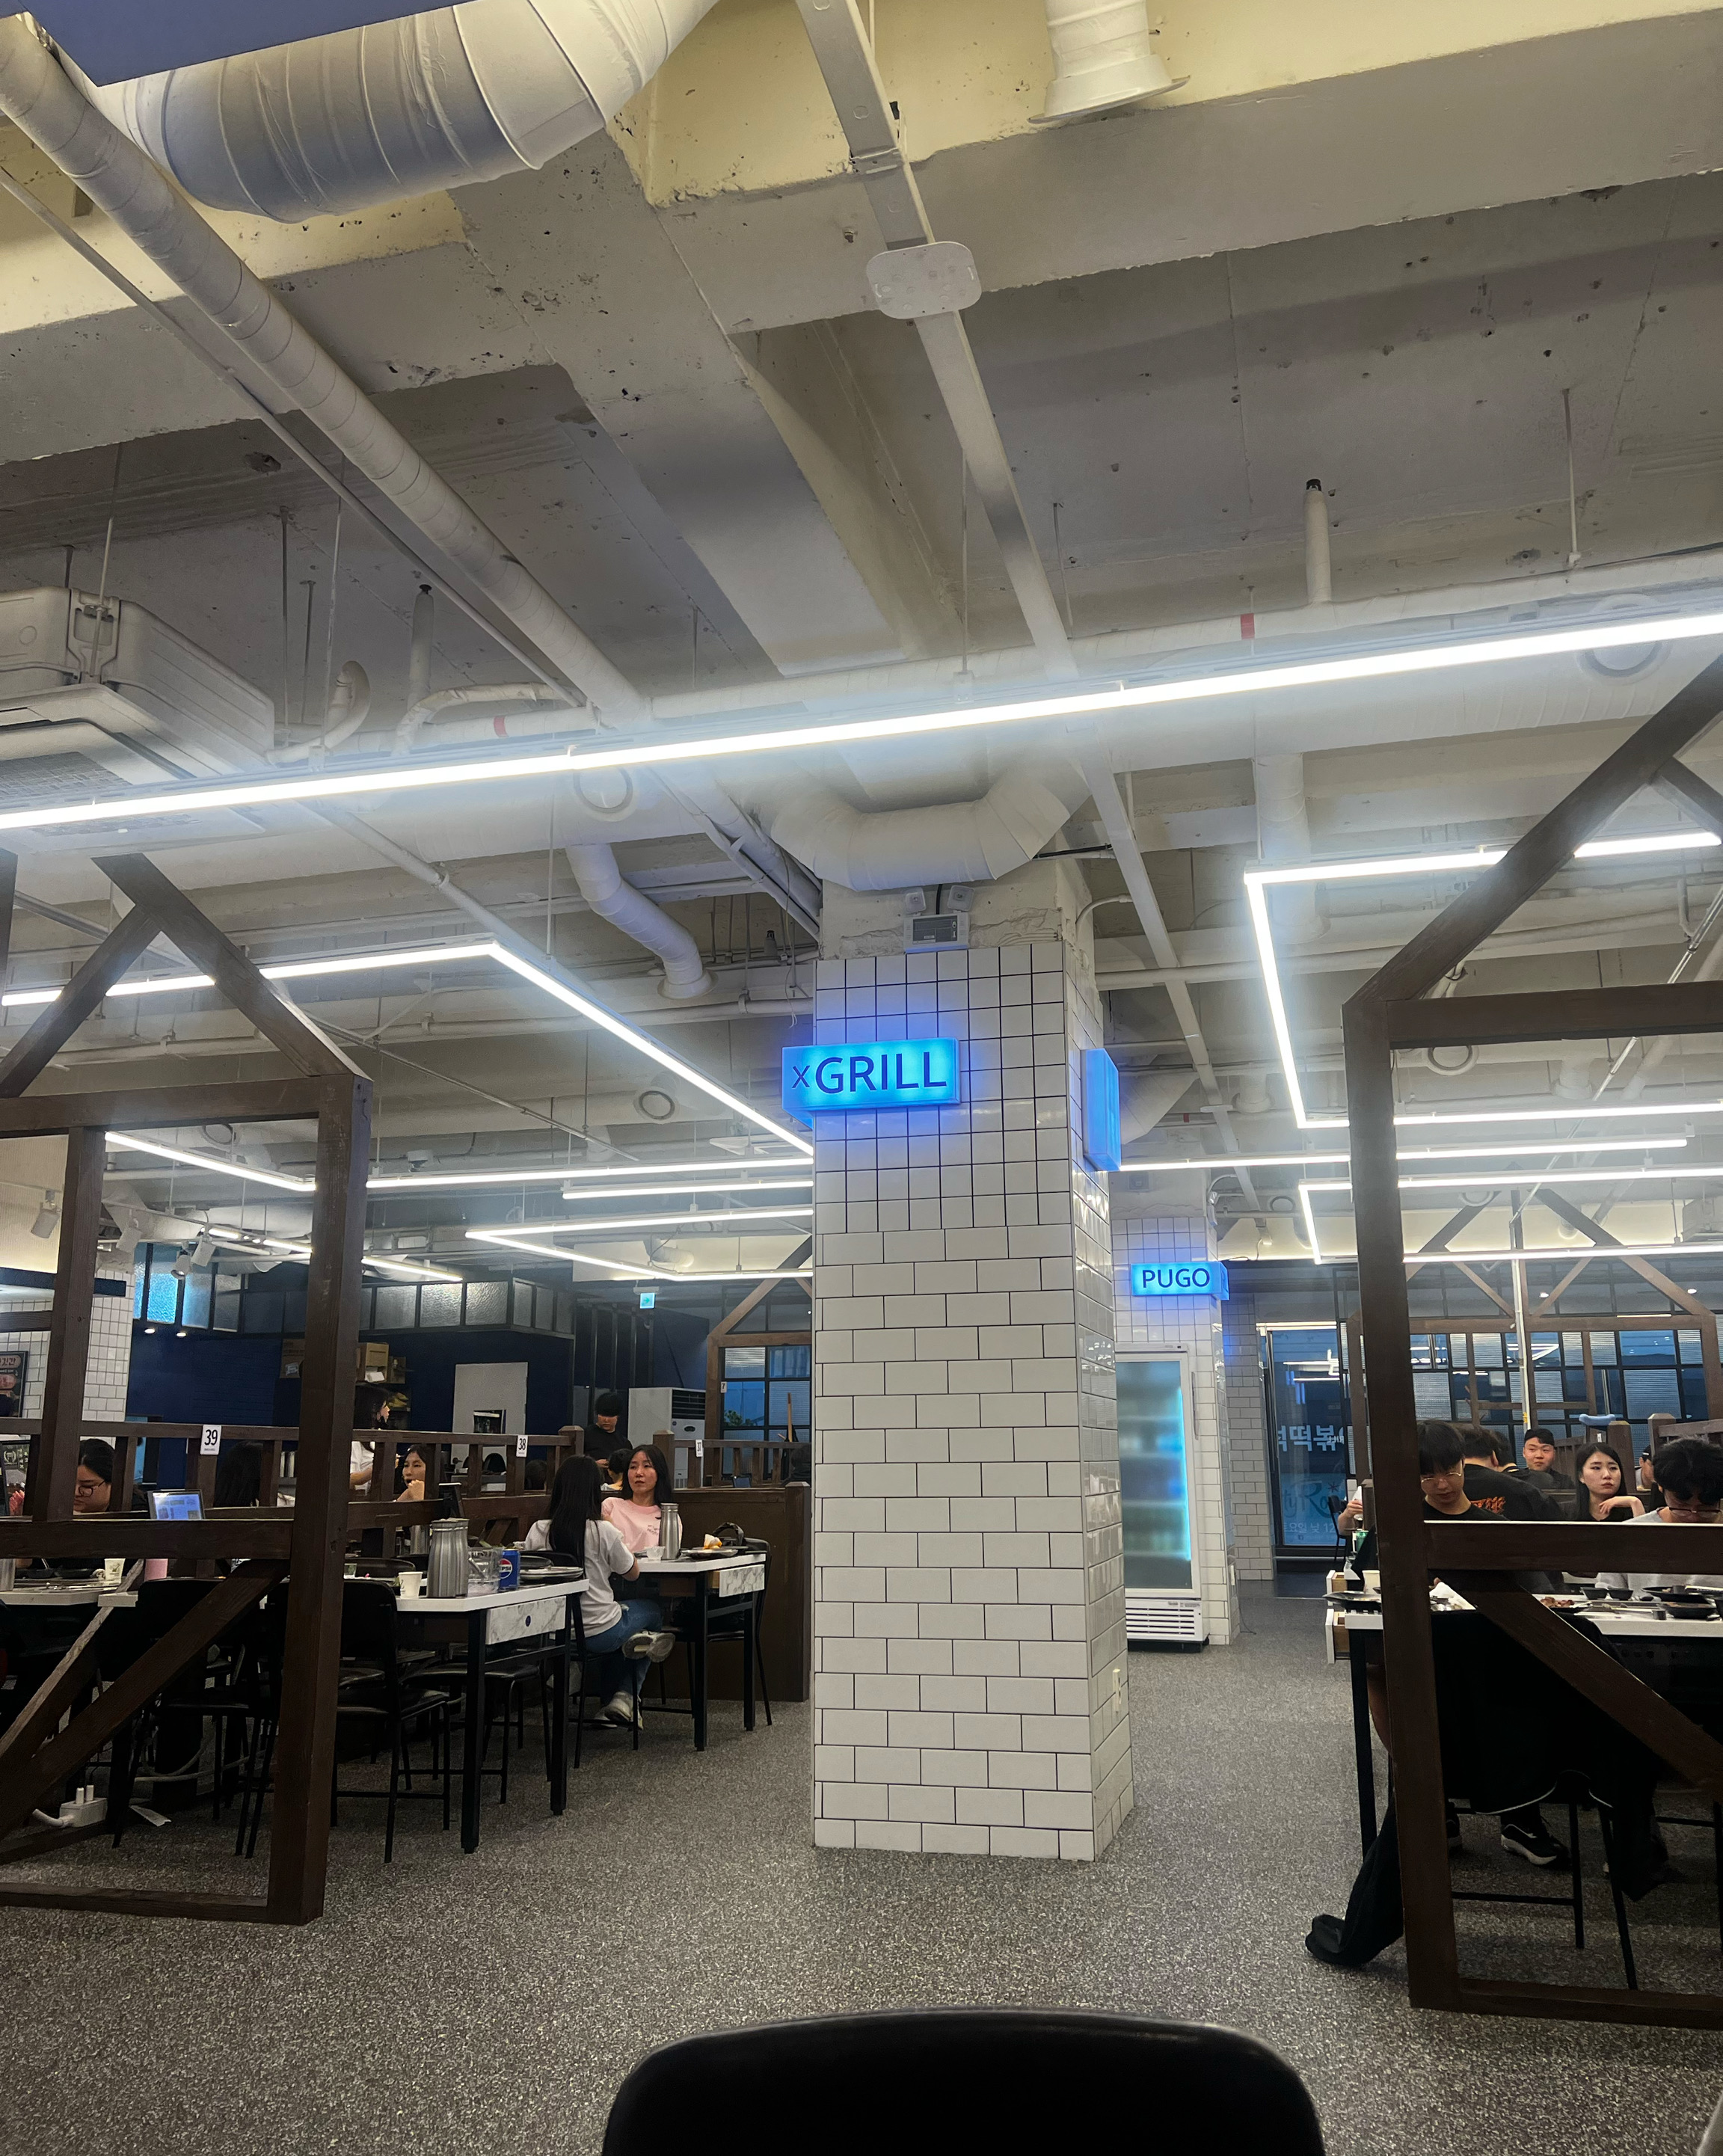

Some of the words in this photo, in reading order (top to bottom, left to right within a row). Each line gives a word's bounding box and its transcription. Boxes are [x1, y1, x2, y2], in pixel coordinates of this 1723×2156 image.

[1142, 1268, 1211, 1289] PUGO
[204, 1429, 218, 1446] 39
[518, 1437, 526, 1451] 38
[1278, 1424, 1344, 1452] 떡볶
[697, 1442, 701, 1452] 37
